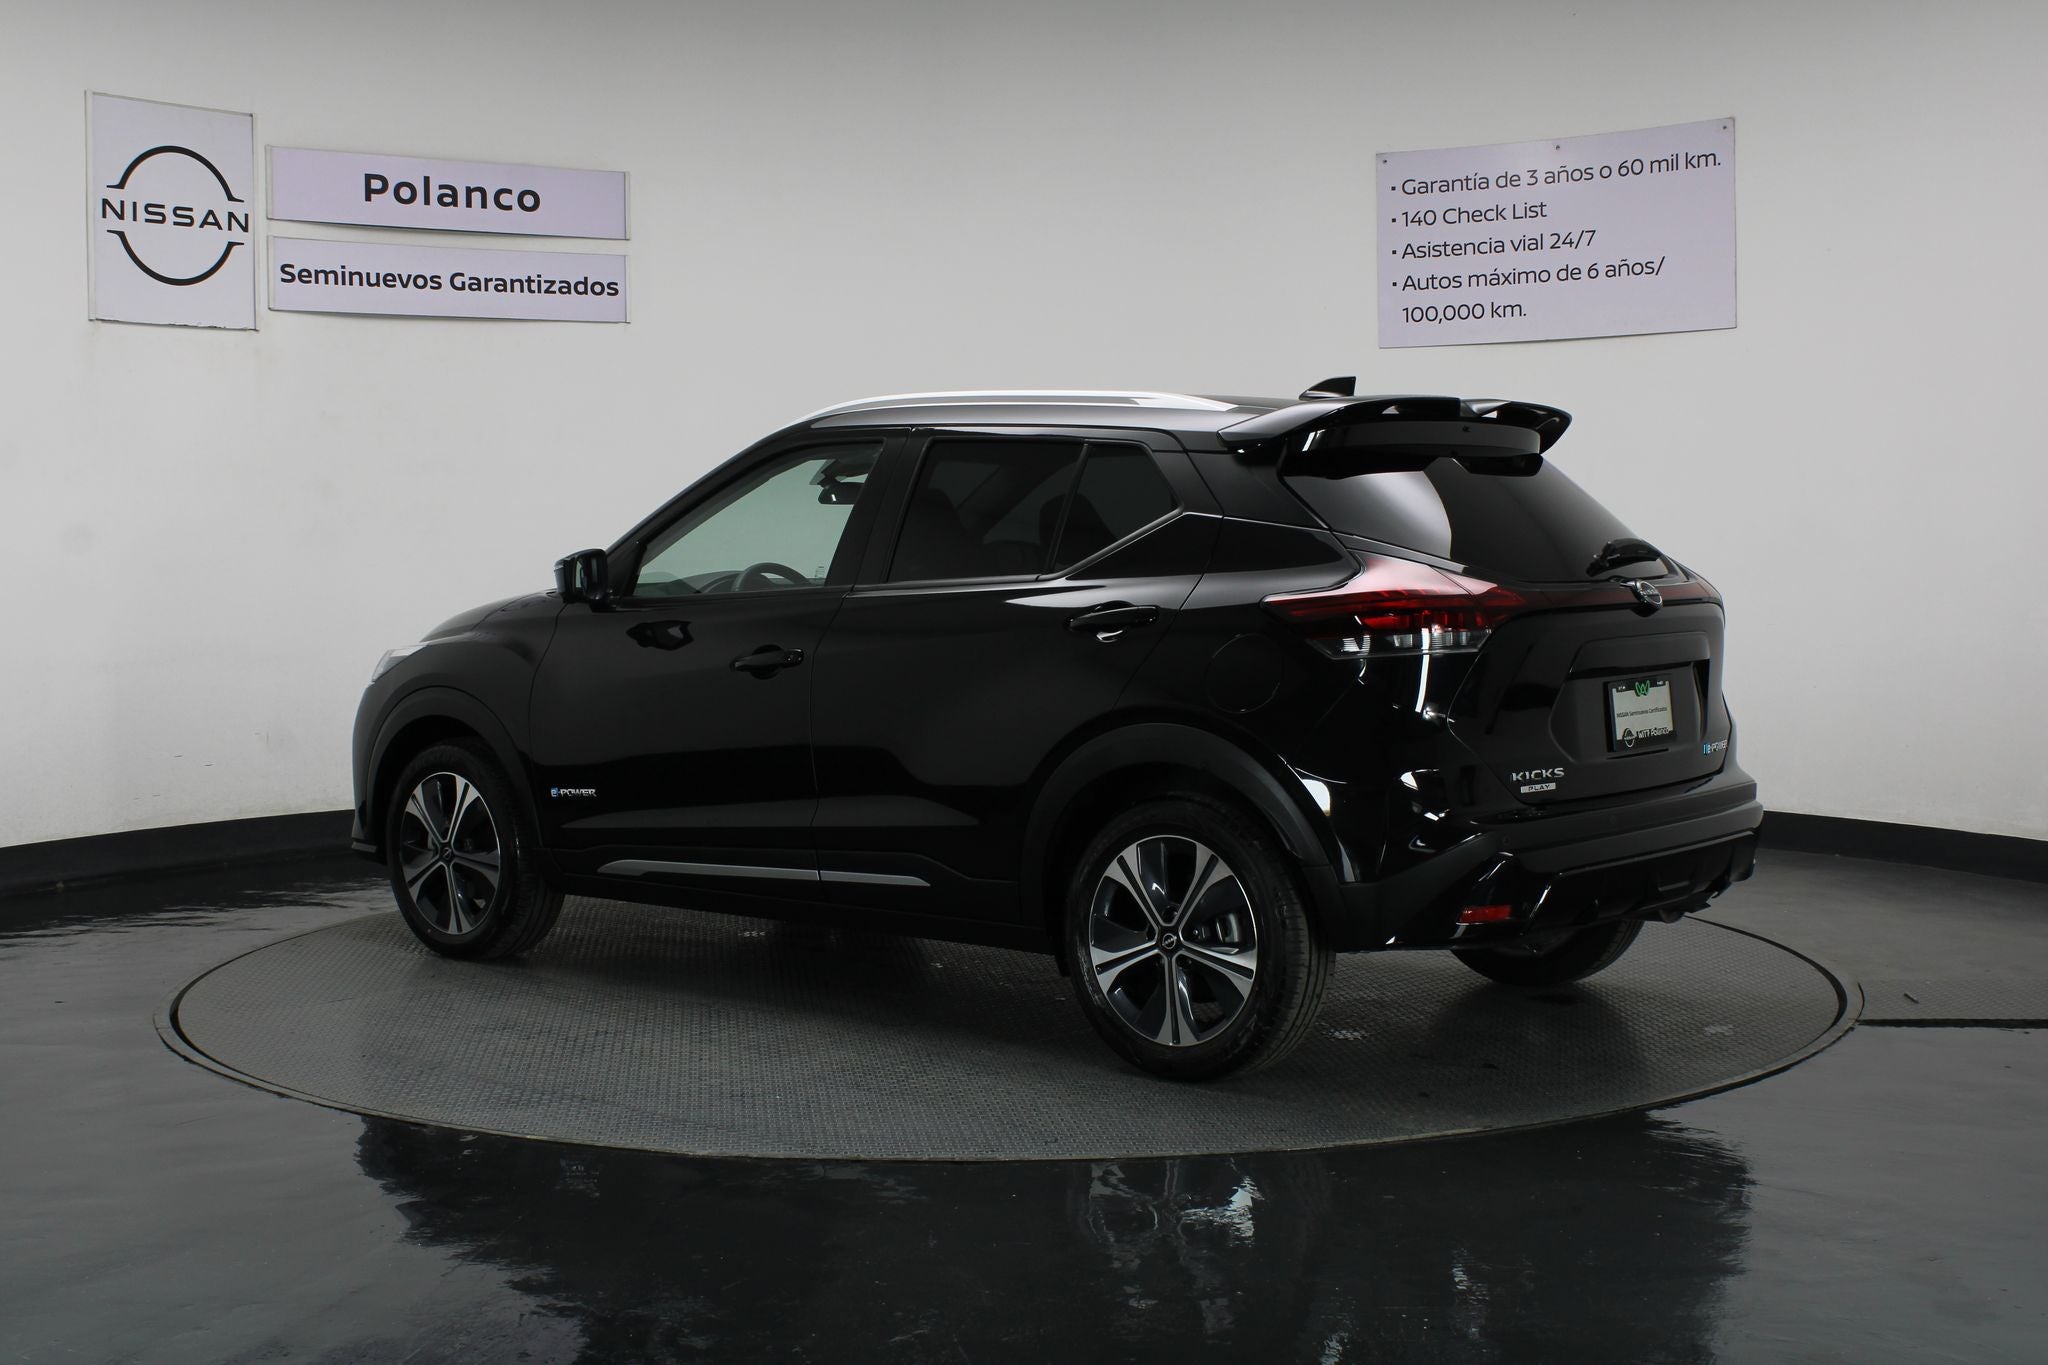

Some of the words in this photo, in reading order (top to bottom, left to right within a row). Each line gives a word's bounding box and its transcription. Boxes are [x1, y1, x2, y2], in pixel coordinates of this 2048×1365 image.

[1401, 172, 1490, 196] Garantía
[1495, 170, 1521, 189] de
[1526, 169, 1539, 186] 3
[1544, 165, 1594, 185] años
[1599, 165, 1613, 179] o
[1617, 158, 1644, 178] 60
[1649, 152, 1680, 174] mil
[1685, 151, 1722, 170] km.
[364, 172, 541, 213] Polanco
[101, 197, 249, 233] NISSAN
[1401, 209, 1437, 228] 140
[1442, 203, 1507, 225] Check
[1512, 201, 1548, 220] List
[1401, 237, 1505, 260] Asistencia
[1509, 232, 1544, 253] vial
[1549, 229, 1597, 250] 24/7
[280, 263, 443, 291] Seminuevos
[449, 272, 620, 297] Garantizados
[1401, 272, 1463, 292] Autos
[1468, 267, 1551, 288] máximo
[1556, 263, 1582, 282] de
[1587, 262, 1600, 280] 6
[1604, 255, 1666, 279] años/
[1402, 302, 1485, 325] 100,000
[1490, 301, 1527, 319] km.
[1511, 767, 1565, 781] KICKS
[550, 788, 597, 798] e-POWER
